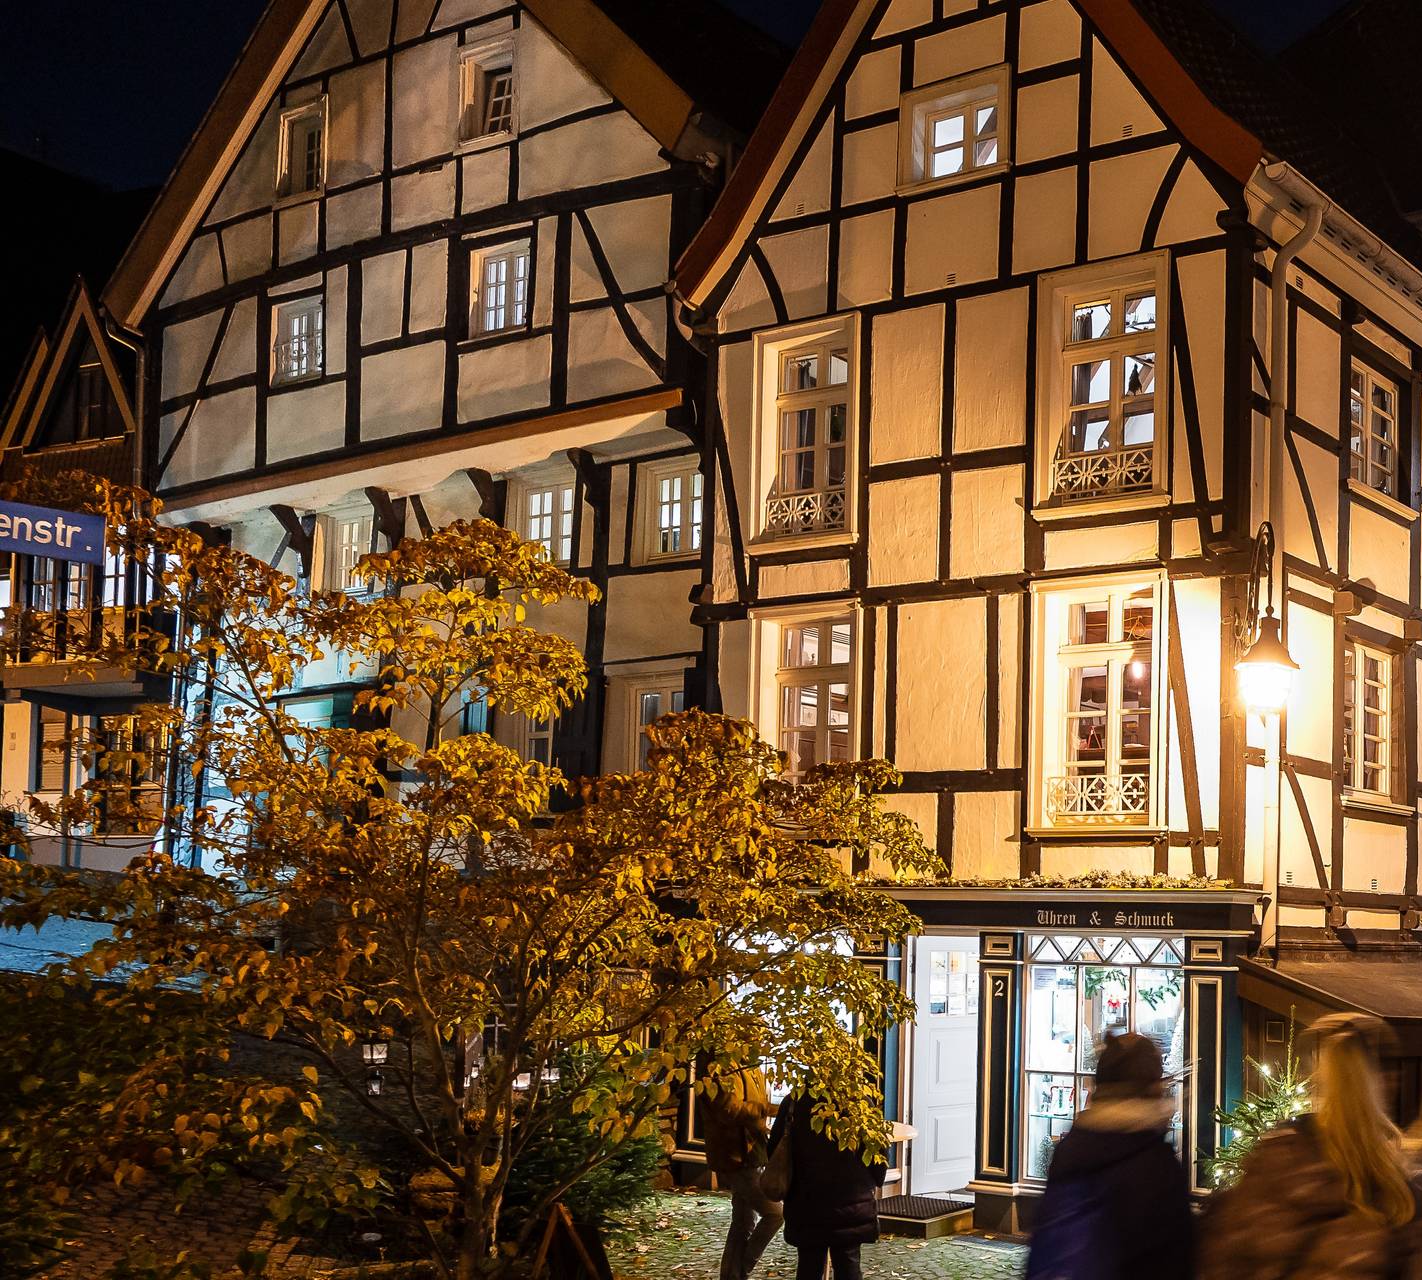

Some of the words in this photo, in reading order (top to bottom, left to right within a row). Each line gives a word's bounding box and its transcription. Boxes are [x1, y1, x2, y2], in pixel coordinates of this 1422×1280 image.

[1037, 909, 1076, 926] Uhren
[1089, 910, 1101, 926] &
[1114, 911, 1175, 928] Schmuck
[994, 979, 1005, 997] 2
